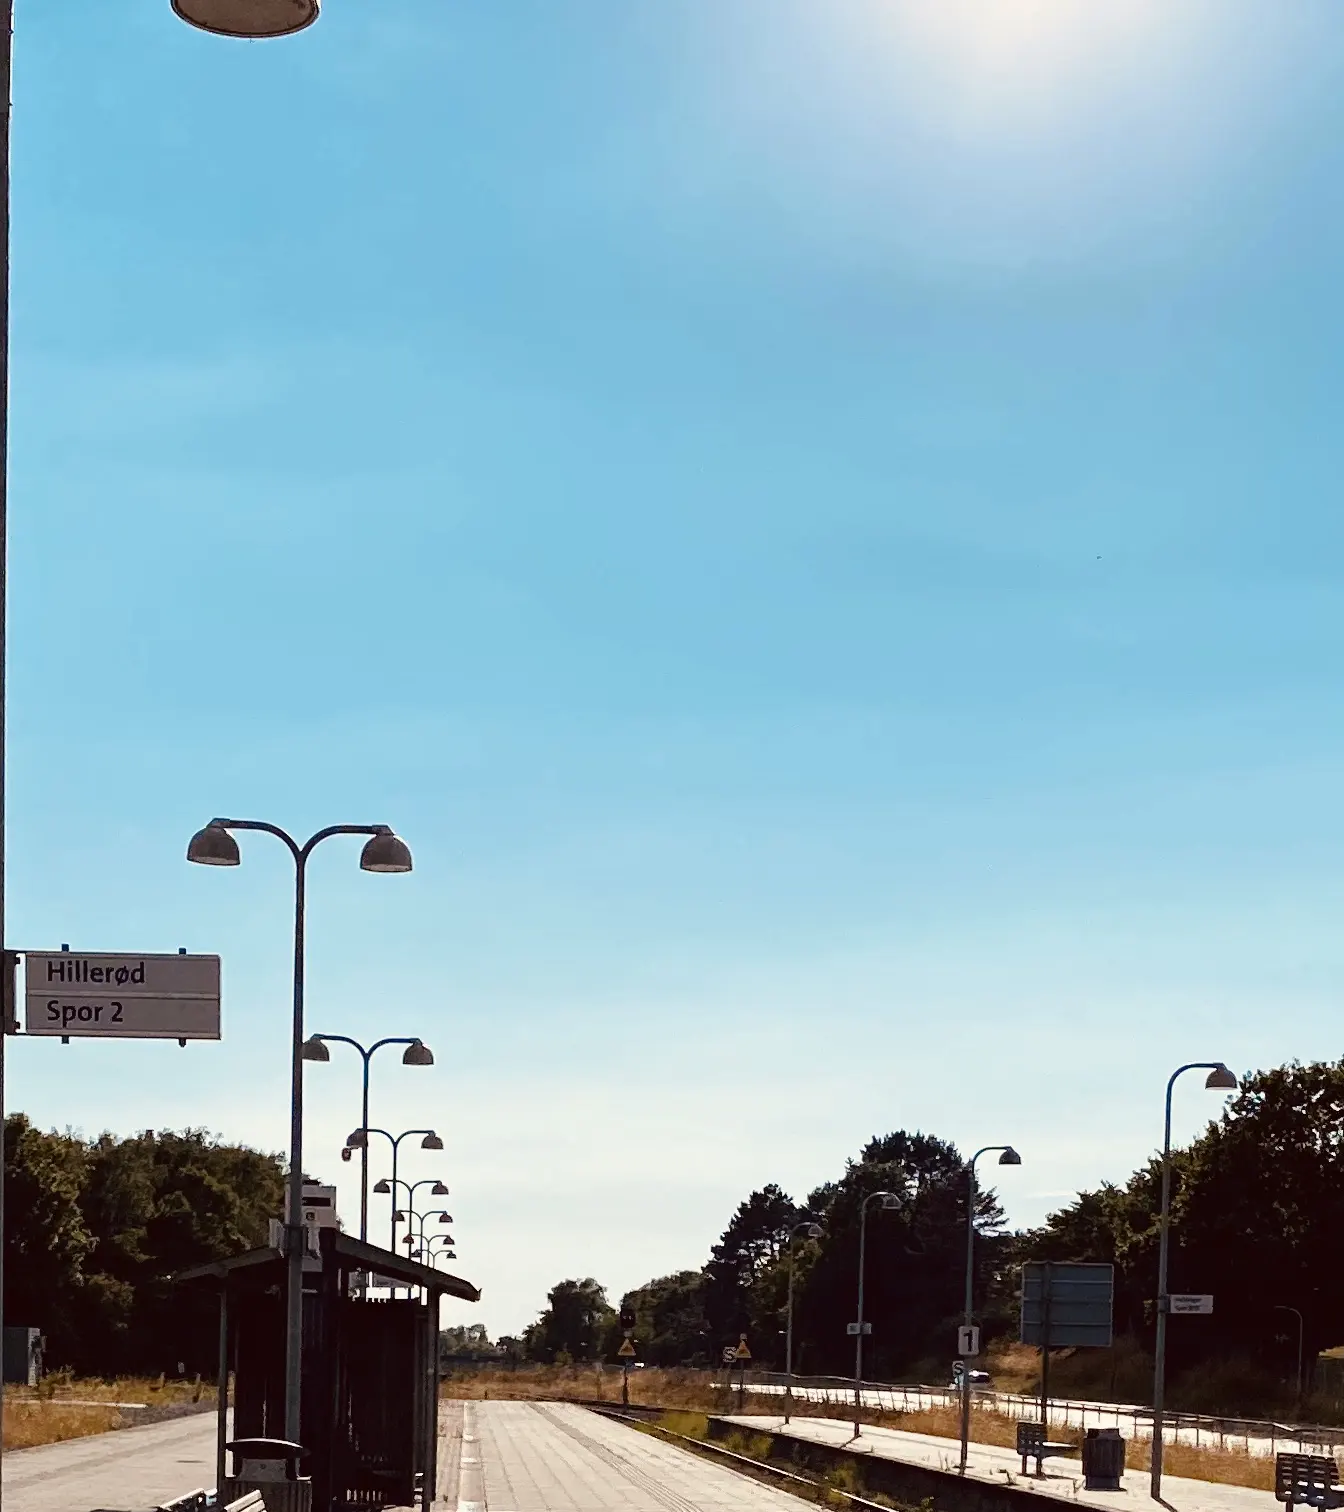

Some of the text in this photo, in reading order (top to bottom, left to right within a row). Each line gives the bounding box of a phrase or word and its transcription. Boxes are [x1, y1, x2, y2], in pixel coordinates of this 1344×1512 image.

[46, 959, 146, 987] Hillerød
[46, 999, 124, 1029] Spor 2
[963, 1329, 973, 1352] 1
